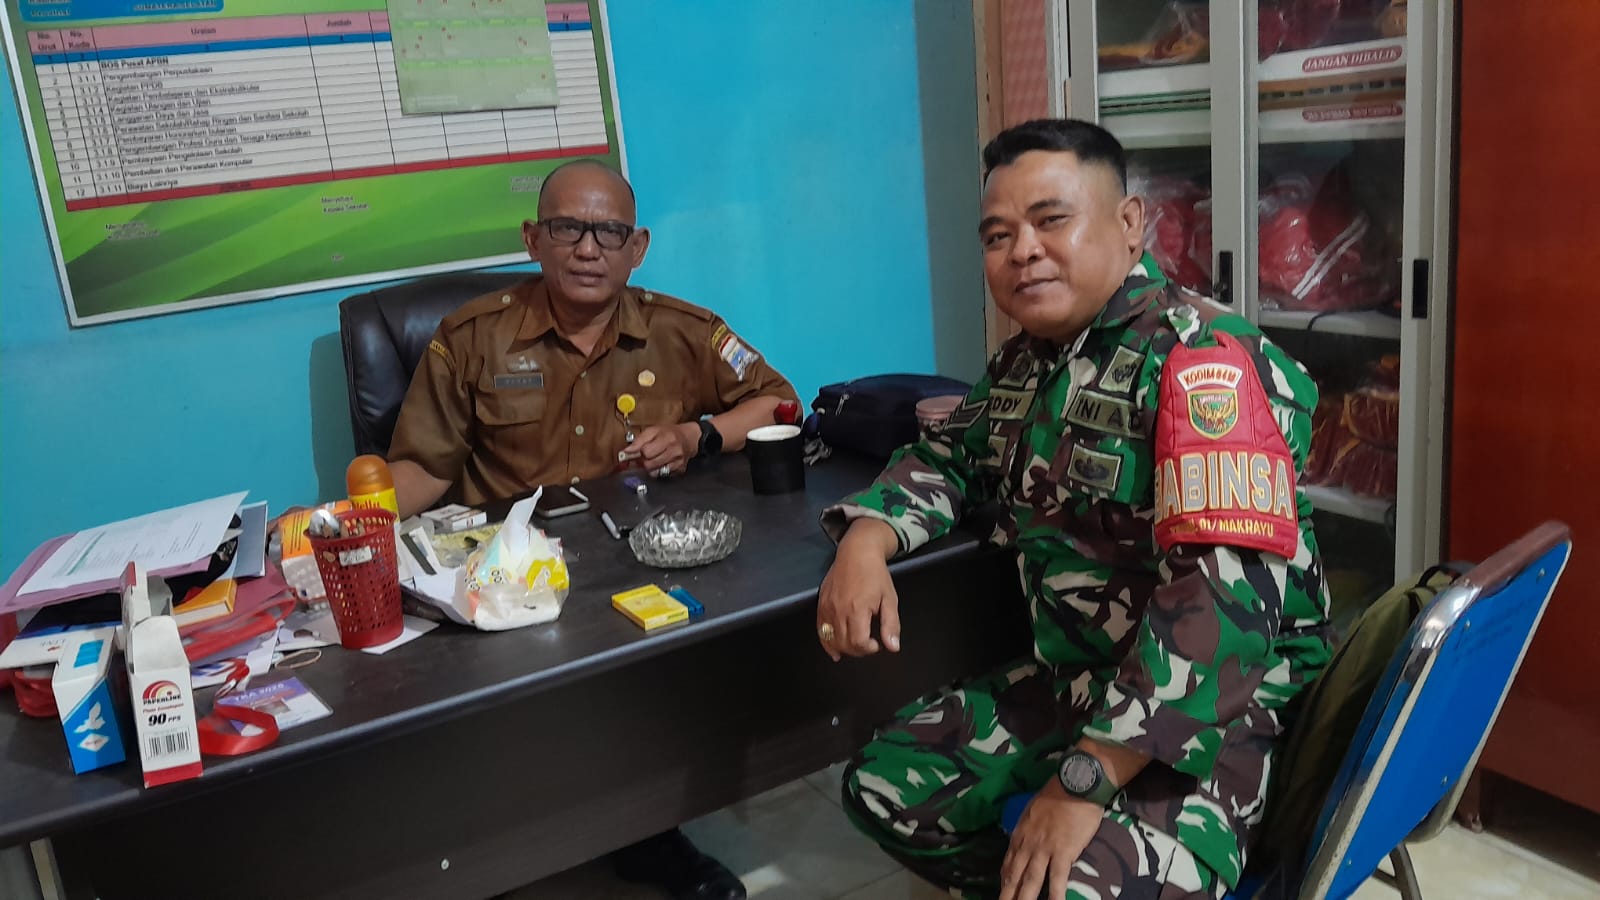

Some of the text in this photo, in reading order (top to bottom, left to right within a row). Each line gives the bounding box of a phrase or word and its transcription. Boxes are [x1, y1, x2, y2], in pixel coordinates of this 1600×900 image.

[100, 60, 119, 68] BOS
[120, 58, 144, 67] Pusat
[144, 56, 168, 64] APBN
[1304, 48, 1398, 71] JANGAN DIBALIK
[165, 164, 178, 173] dan
[143, 694, 182, 705] PAPERLINE
[148, 712, 167, 727] 90
